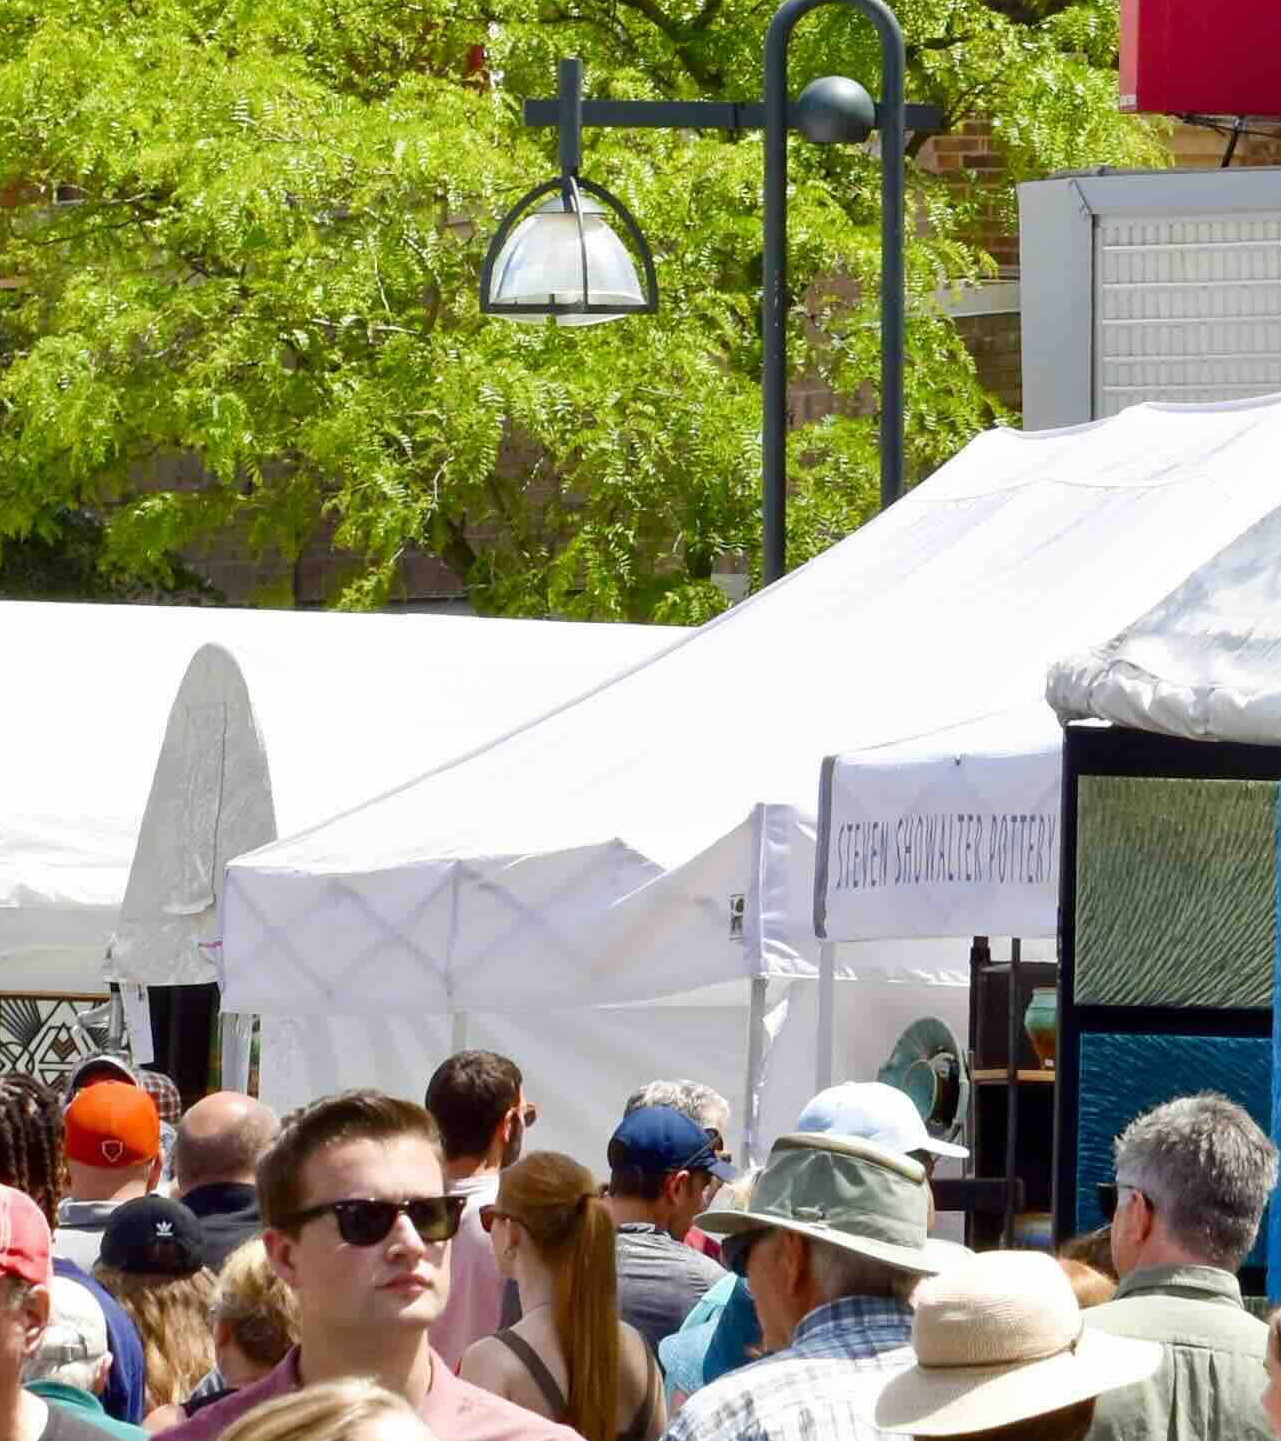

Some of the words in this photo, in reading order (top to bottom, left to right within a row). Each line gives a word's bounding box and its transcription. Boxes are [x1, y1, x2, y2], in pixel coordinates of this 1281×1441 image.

[836, 821, 889, 889] STEVEN
[895, 815, 983, 886] SHOWALTER
[989, 814, 1056, 884] POTTERY
